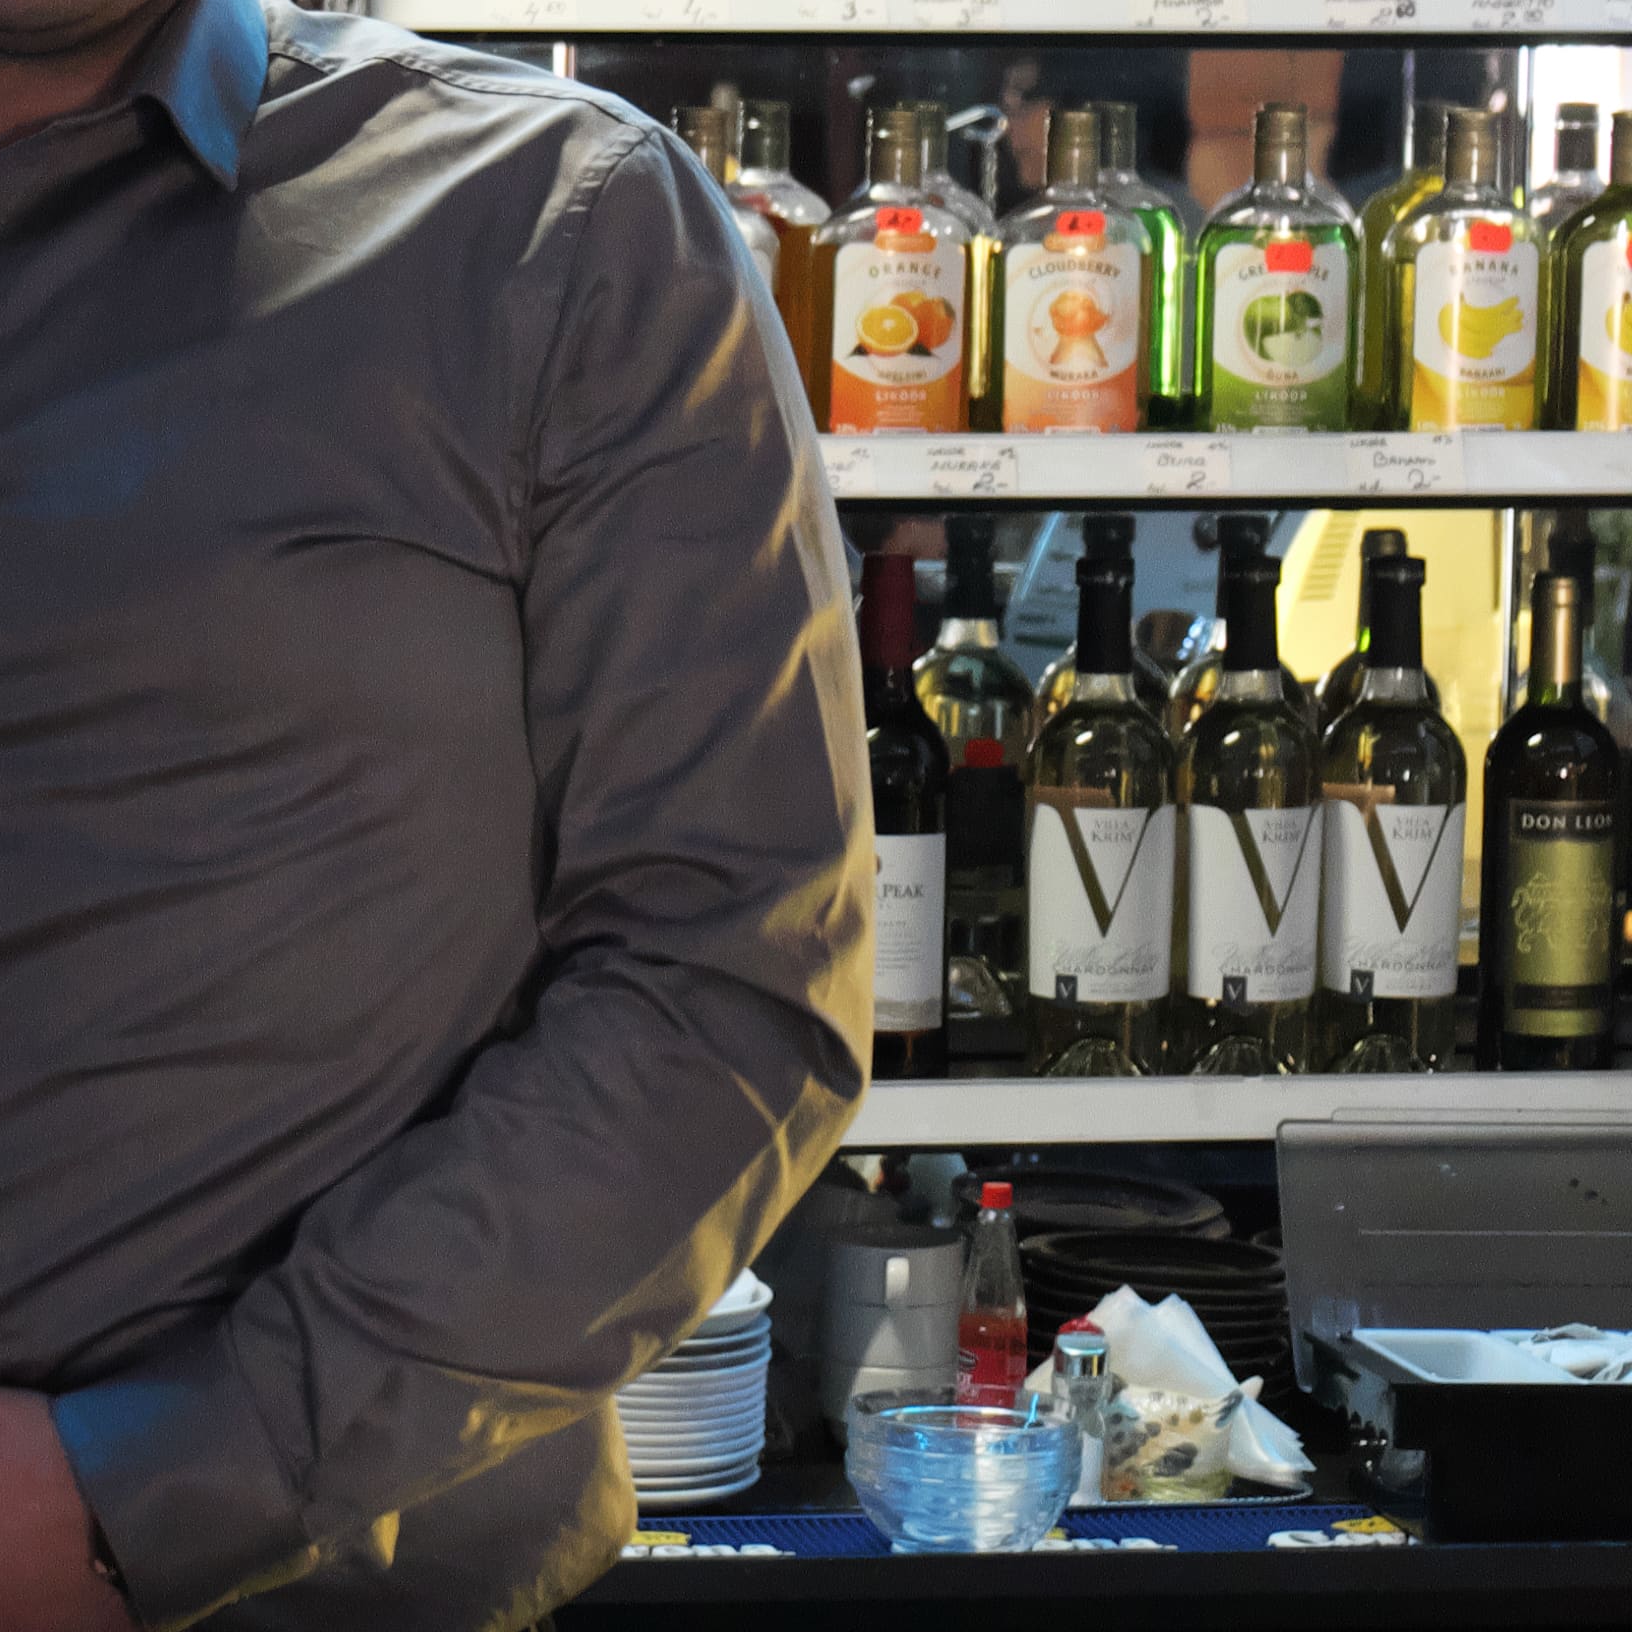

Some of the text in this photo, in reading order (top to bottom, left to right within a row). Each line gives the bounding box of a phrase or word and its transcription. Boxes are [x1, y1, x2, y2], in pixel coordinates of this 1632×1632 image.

[869, 261, 944, 280] ORANGE
[1029, 259, 1122, 279] CLOUDBERRY
[1521, 814, 1566, 830] DON
[1091, 830, 1135, 843] KRIM
[883, 884, 924, 898] PEAK
